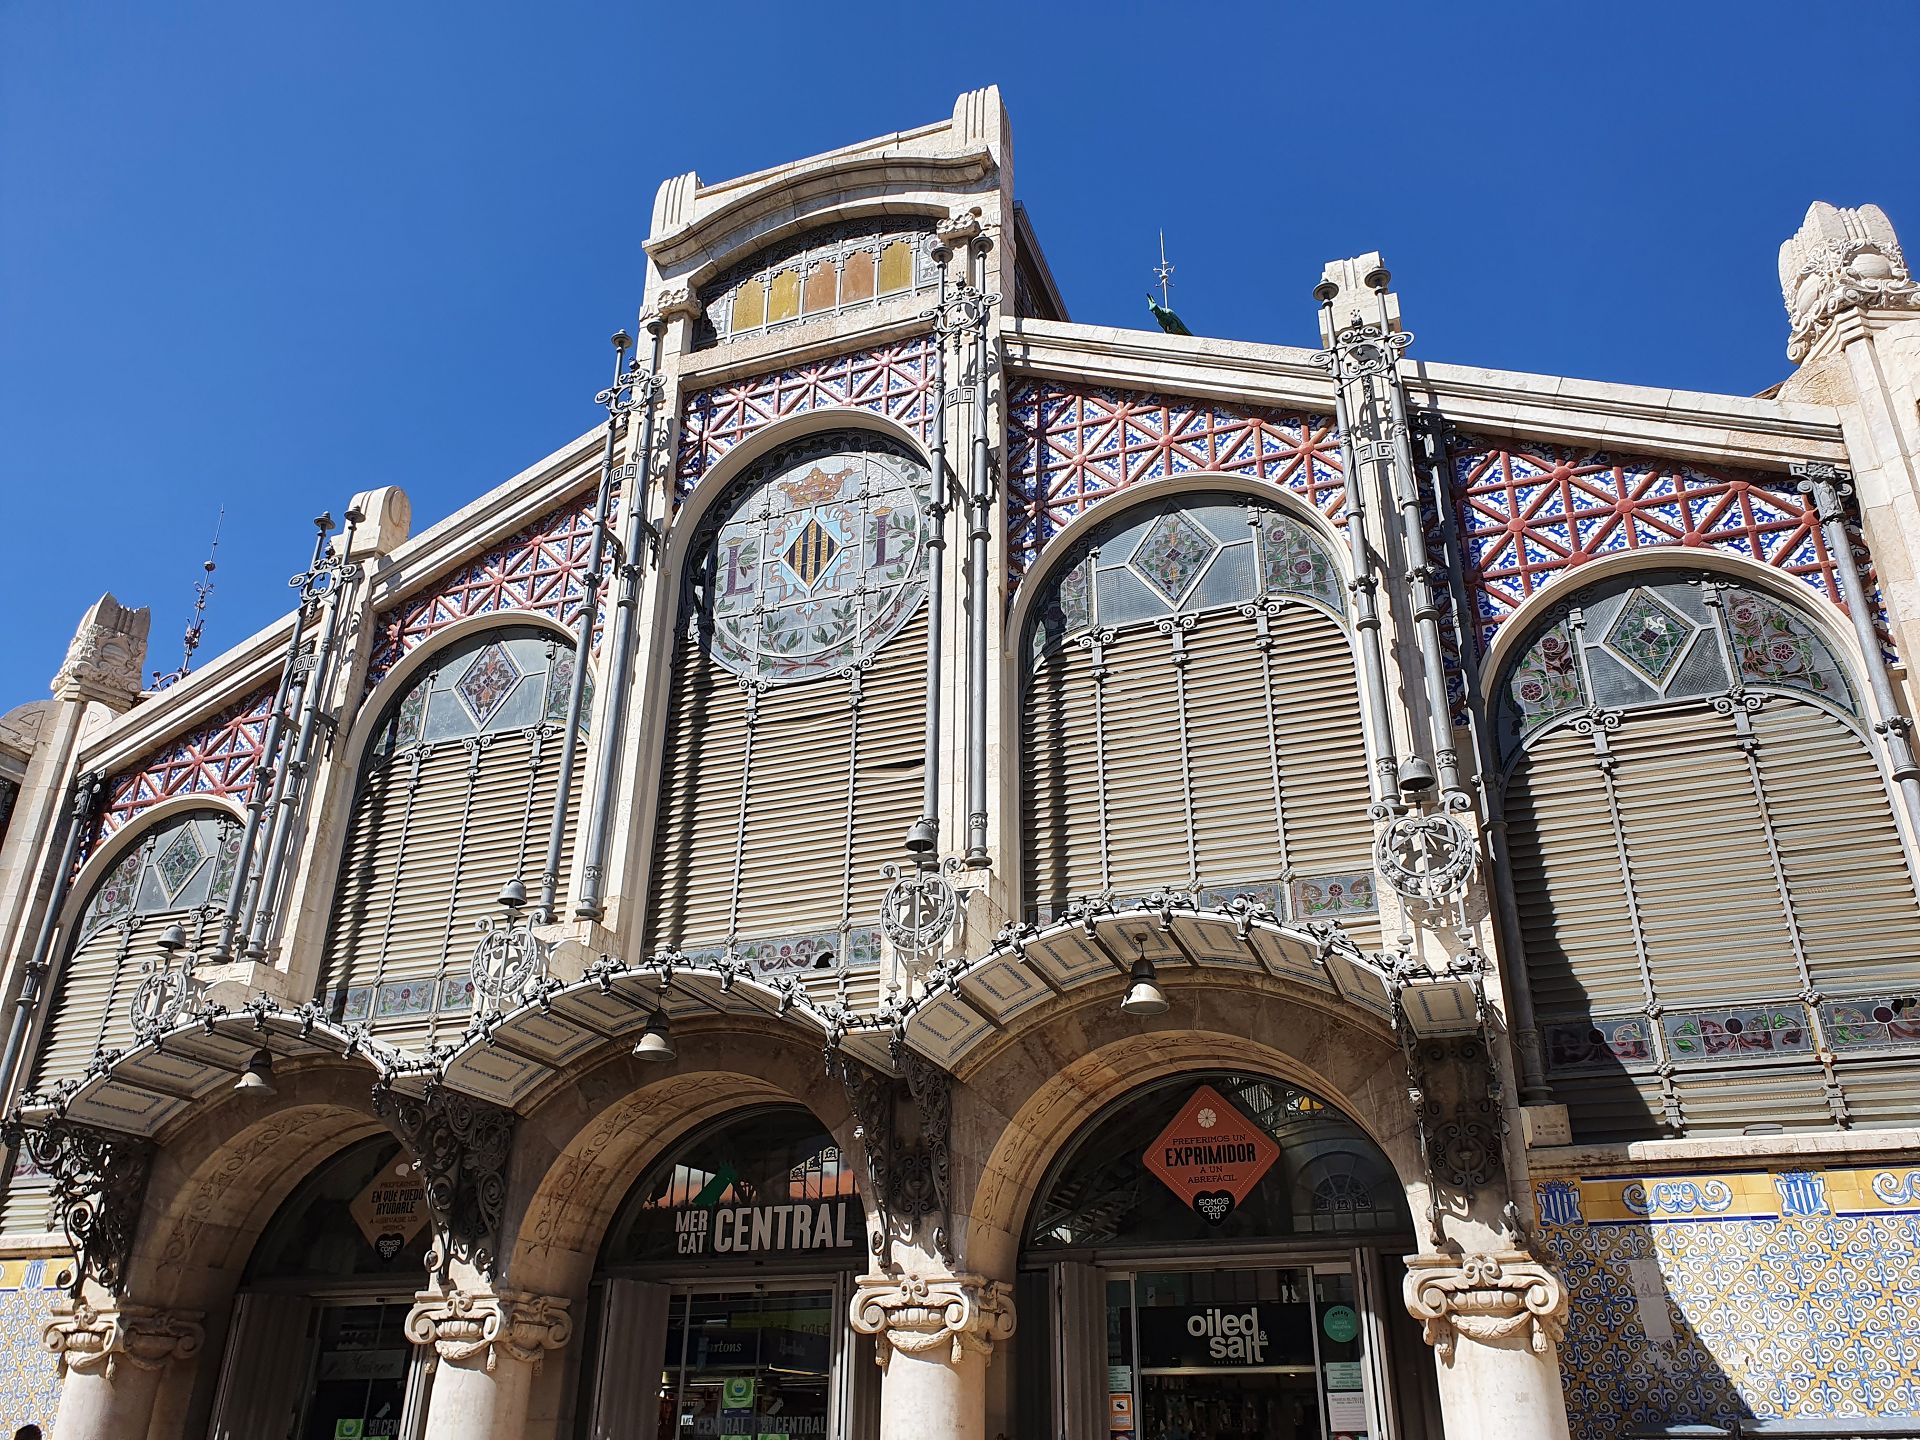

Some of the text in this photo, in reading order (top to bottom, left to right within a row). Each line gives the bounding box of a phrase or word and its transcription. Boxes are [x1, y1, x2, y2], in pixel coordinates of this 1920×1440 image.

[1173, 1134, 1246, 1145] PREFERIMOS UN
[1165, 1143, 1256, 1167] EXPRIMIDOR
[1187, 1174, 1238, 1184] ABREFÁCIL
[1198, 1197, 1230, 1206] SOMOS
[1202, 1205, 1227, 1213] COMO
[675, 1209, 708, 1233] MER
[713, 1202, 853, 1253] CENTRAL
[677, 1231, 707, 1254] CAT
[1187, 1307, 1259, 1338] oiled
[1209, 1336, 1268, 1364] salt
[775, 1416, 826, 1434] CENTRAL
